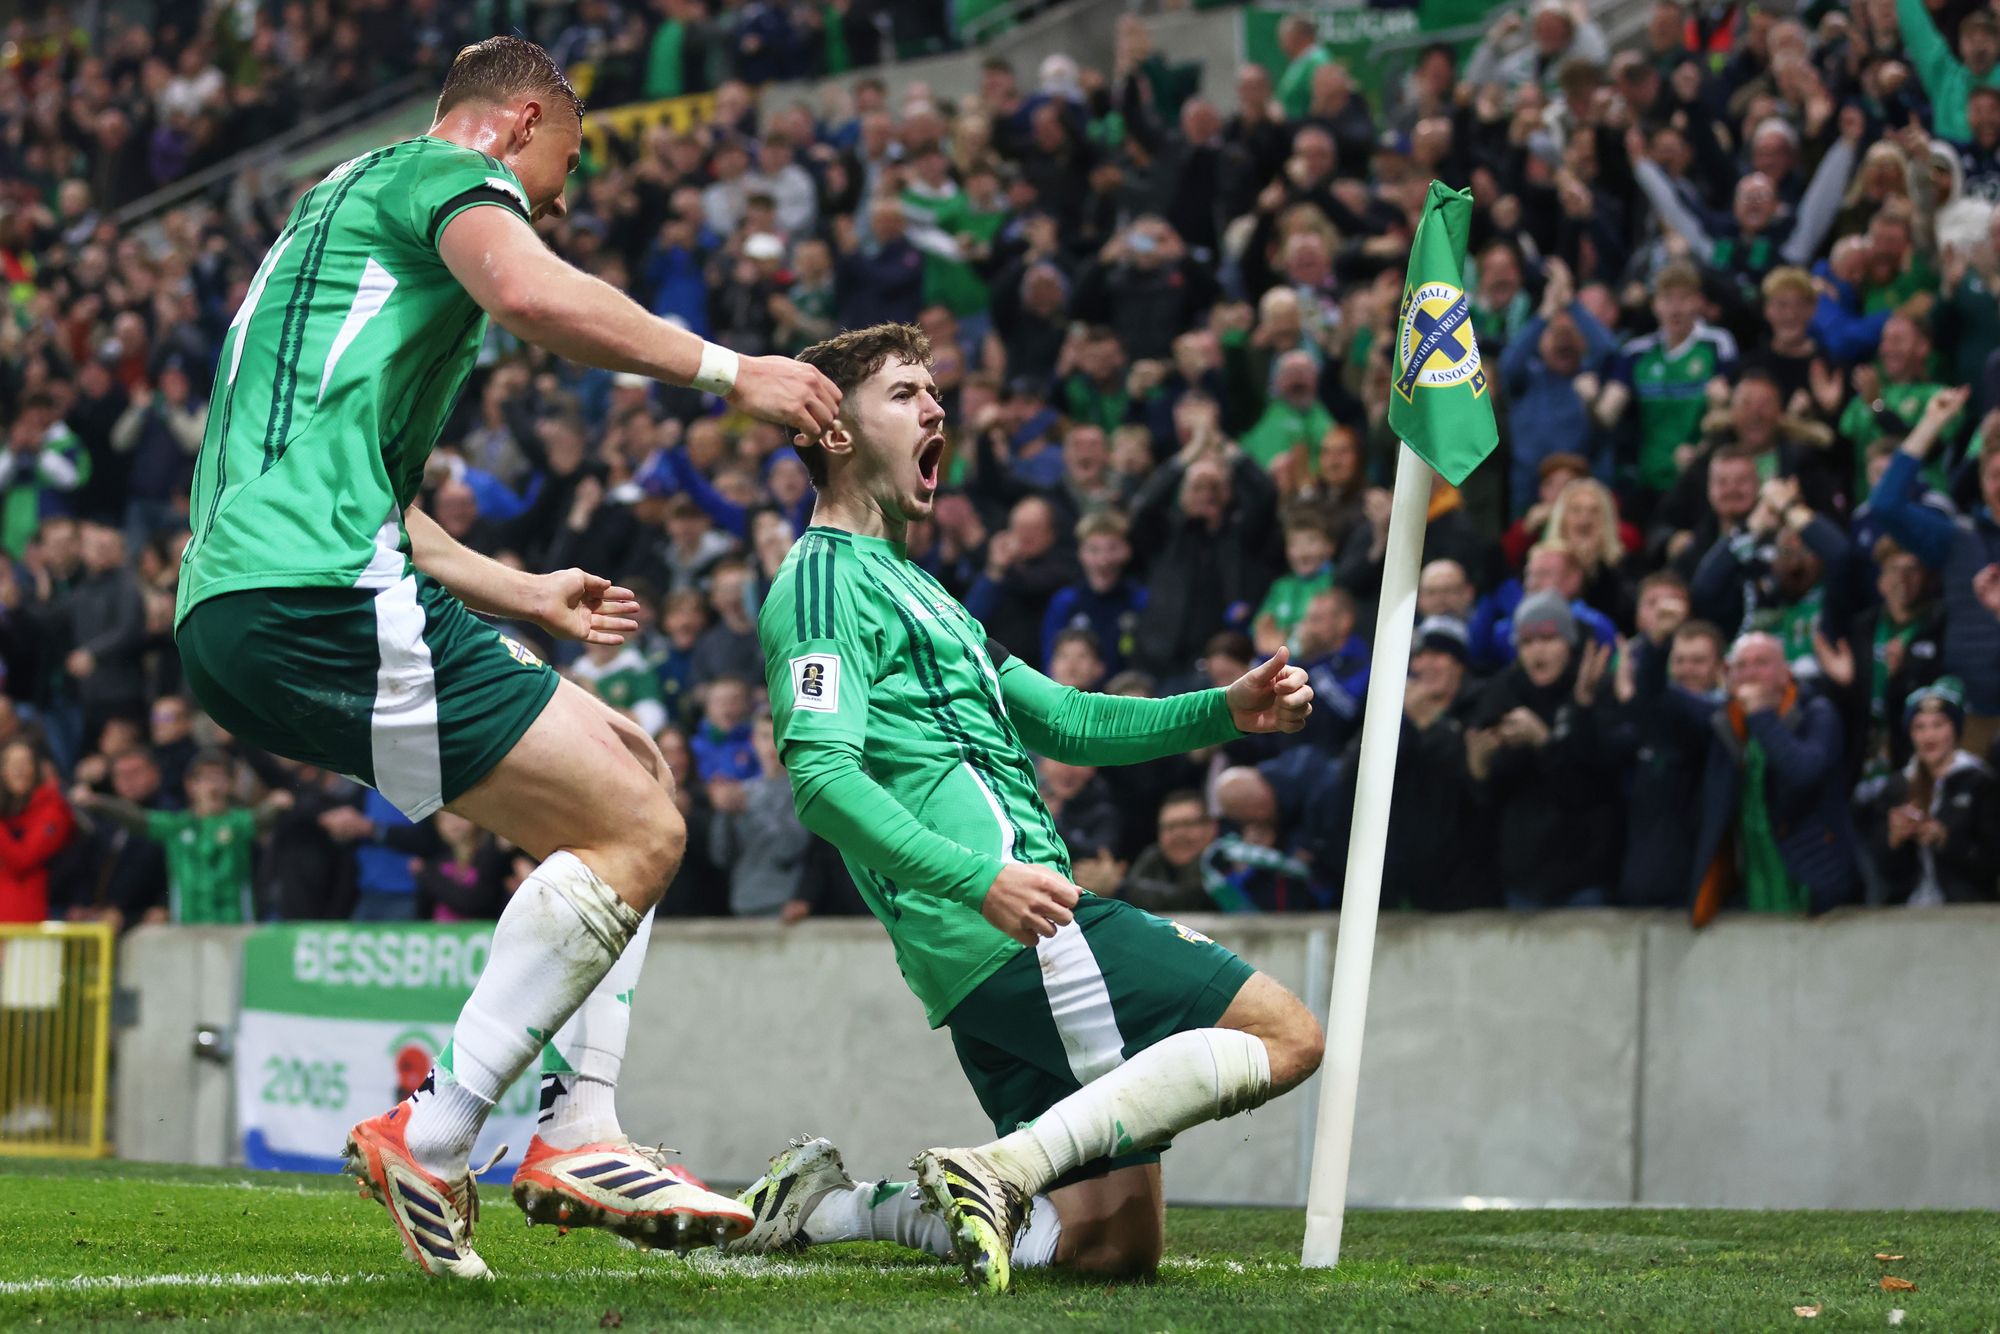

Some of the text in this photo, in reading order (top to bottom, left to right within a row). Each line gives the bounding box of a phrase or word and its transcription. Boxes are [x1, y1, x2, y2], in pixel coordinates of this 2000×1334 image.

[1407, 287, 1451, 326] FOOTBALL
[1407, 301, 1468, 378] NORTHERN IRELAN
[295, 932, 489, 987] BESSBRO
[262, 1056, 348, 1110] 2005
